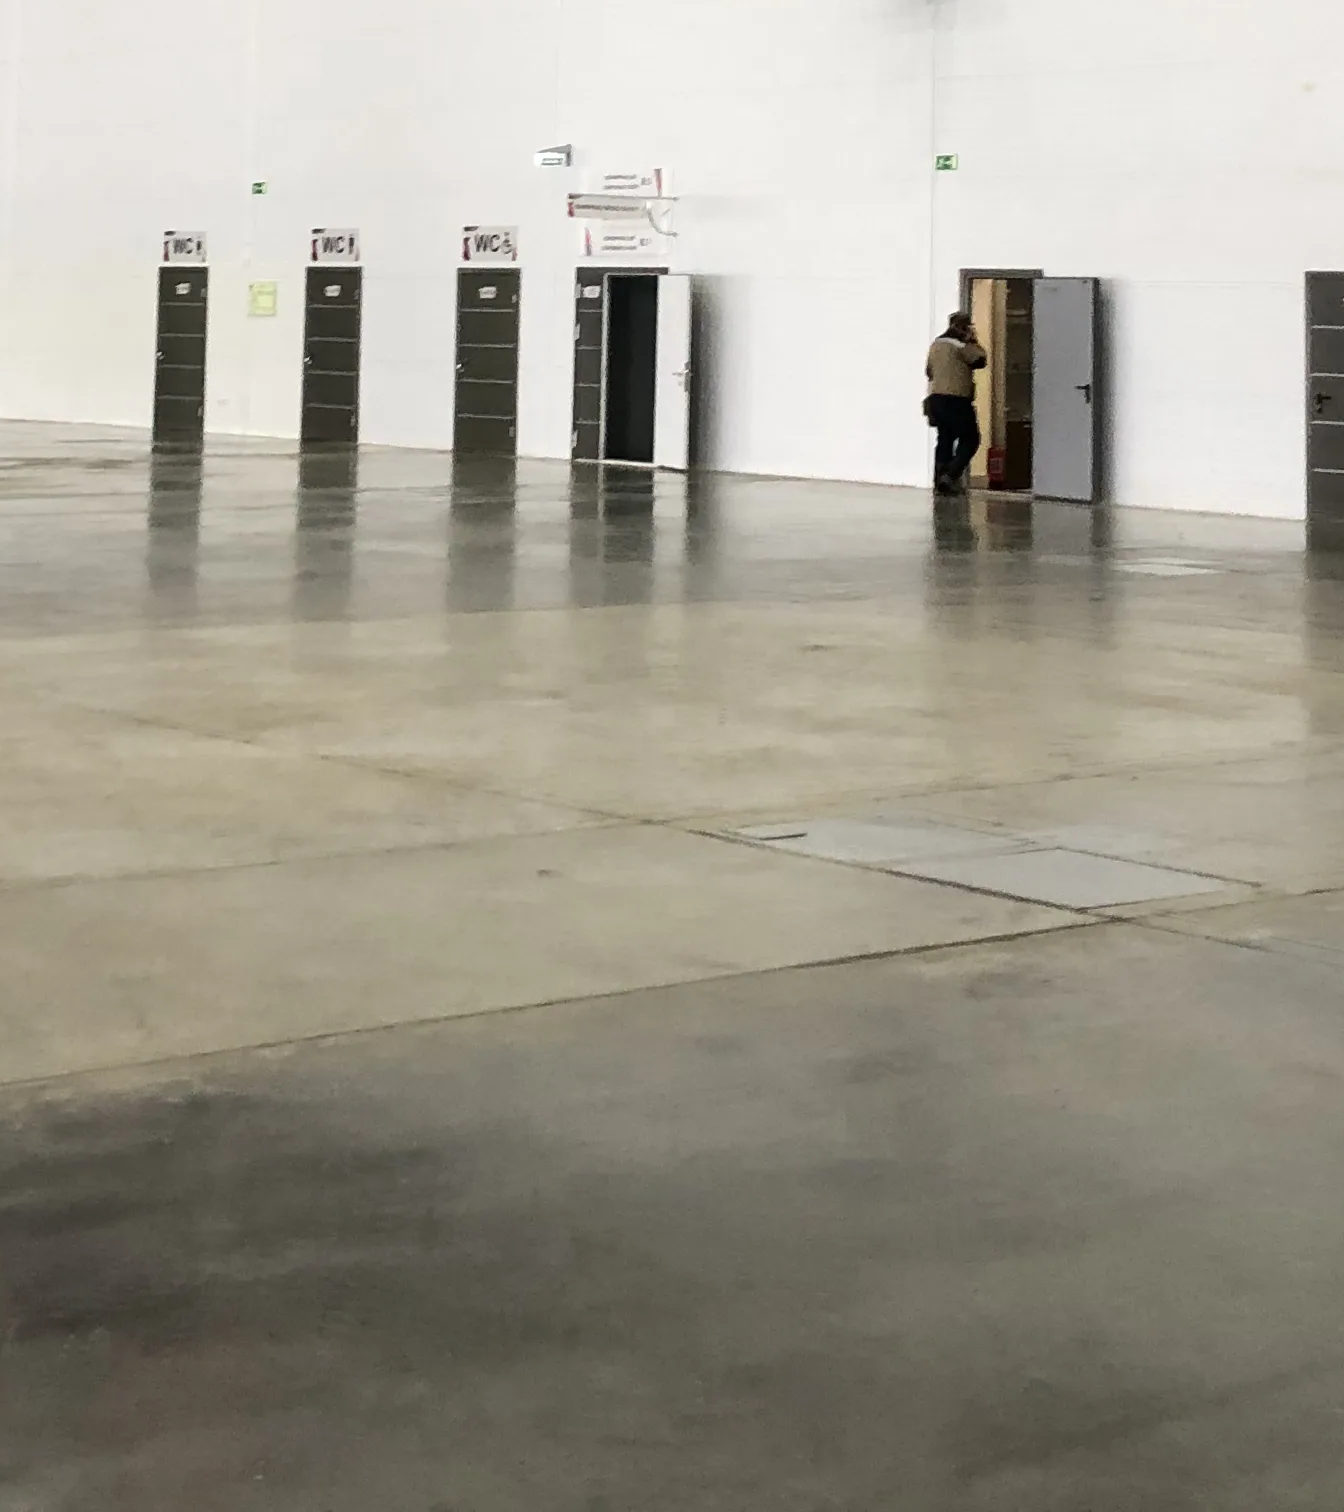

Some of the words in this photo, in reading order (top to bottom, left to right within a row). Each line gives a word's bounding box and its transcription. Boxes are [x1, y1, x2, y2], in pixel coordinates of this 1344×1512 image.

[172, 238, 193, 254] WC
[322, 236, 344, 253] WC
[474, 234, 500, 252] WC
